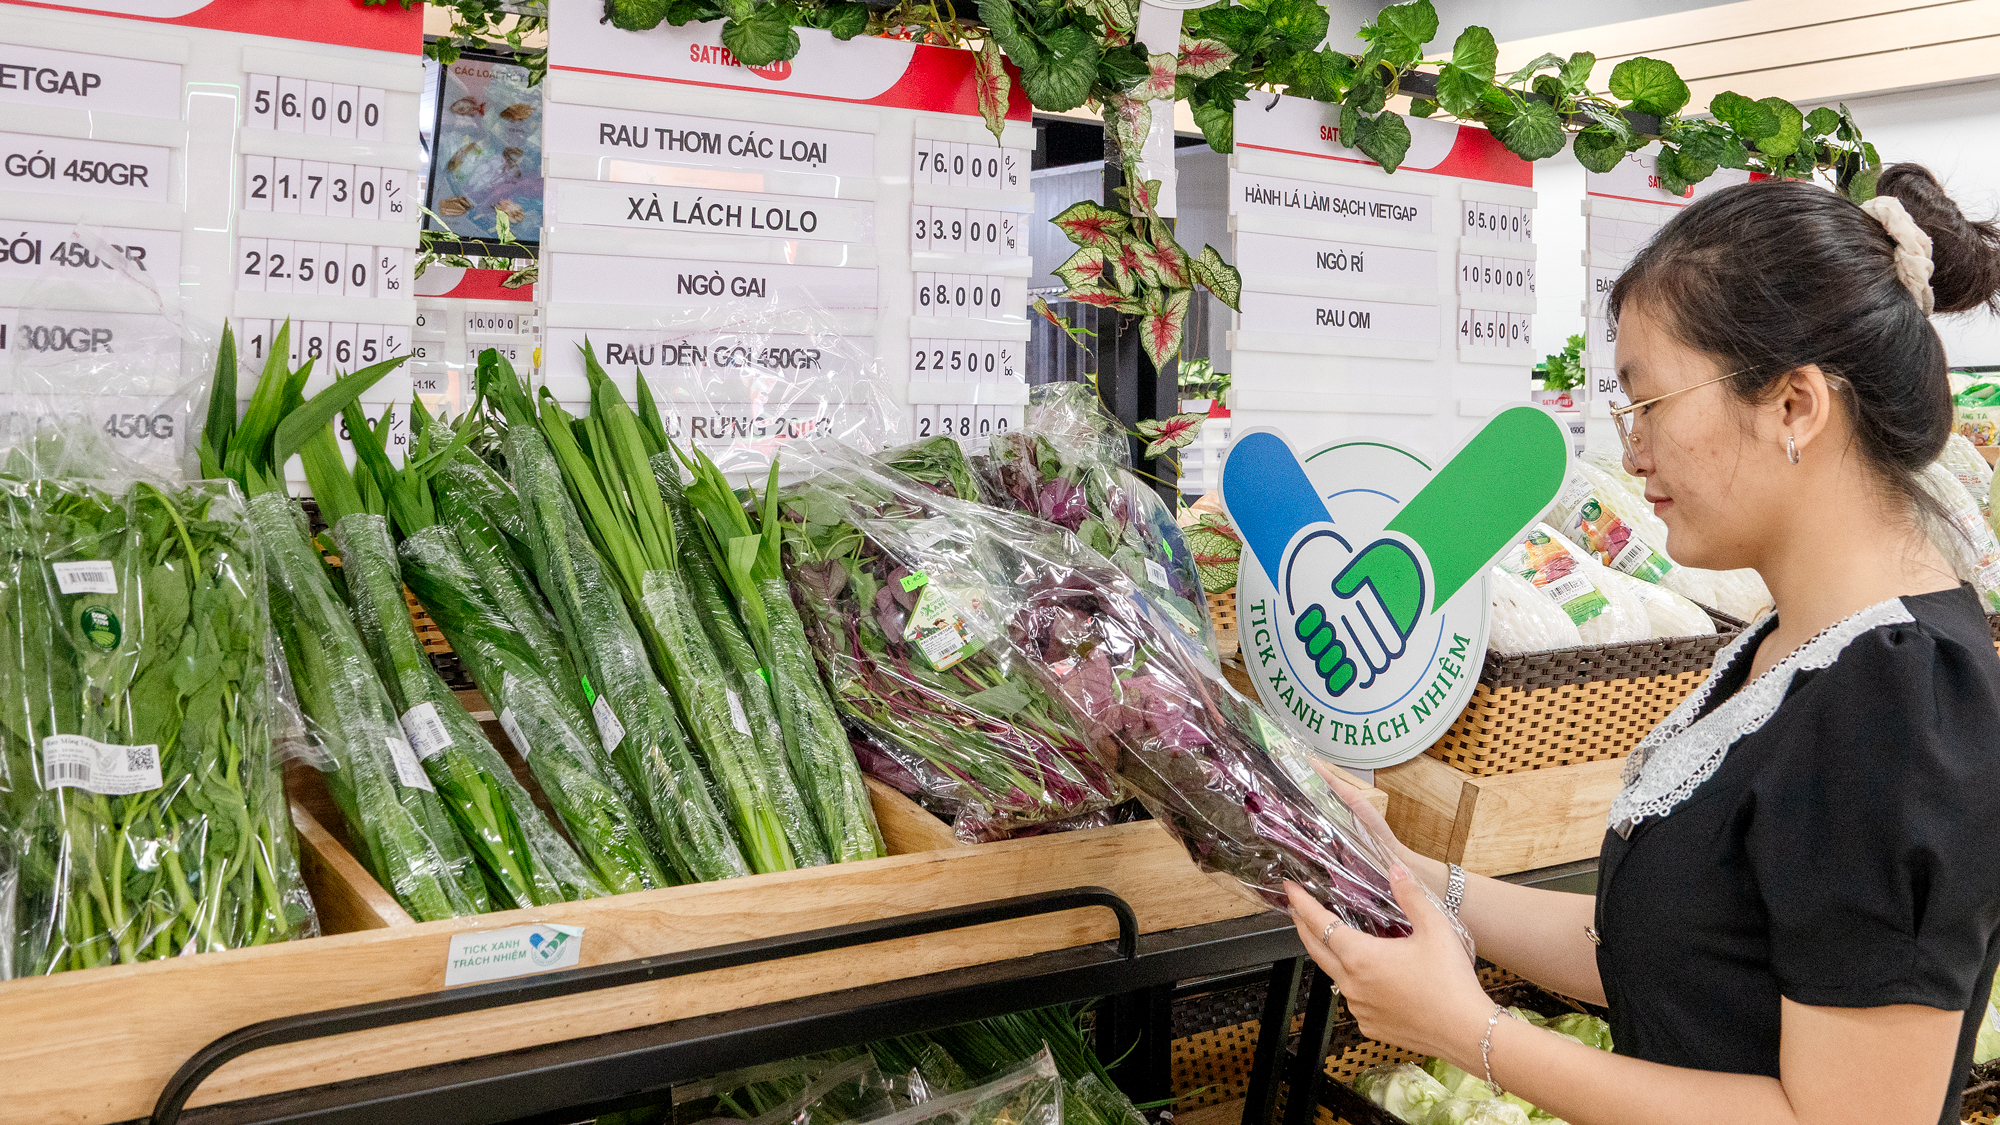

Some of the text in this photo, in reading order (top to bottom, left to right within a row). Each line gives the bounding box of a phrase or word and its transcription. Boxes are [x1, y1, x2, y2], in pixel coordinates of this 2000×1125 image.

[454, 66, 475, 76] CÁC
[254, 90, 379, 127] 56.000
[599, 123, 827, 168] RAU THƠM CÁC LOẠI
[4, 150, 149, 188] GÓI 450GR
[918, 152, 998, 178] 76.000
[251, 175, 375, 205] 21.730
[1008, 173, 1017, 185] kg
[390, 201, 403, 213] bó
[627, 193, 818, 233] XÀ LÁCH LOLO
[1245, 184, 1418, 222] HÀNH LÁ LÀM SẠCH VIETGAP
[915, 219, 997, 243] 33.900
[1468, 210, 1519, 233] 85.000
[1006, 237, 1015, 249] kg
[50, 242, 147, 272] 450R
[244, 251, 366, 287] 22.500
[1316, 249, 1364, 273] NGÒ RÍ
[387, 277, 400, 290] bó
[677, 271, 766, 299] NGÒ GAI
[1462, 265, 1523, 287] 105000
[920, 284, 1001, 308] 68.000
[468, 318, 513, 330] 10.000
[1316, 308, 1370, 329] RAU OM
[1461, 320, 1519, 340] 46.500
[18, 324, 114, 353] 300GR
[251, 334, 377, 363] 1.865
[470, 349, 516, 360] 175
[606, 343, 655, 366] RAU
[756, 347, 822, 370] 450GR
[915, 350, 995, 373] 22500
[103, 413, 174, 440] 450G
[919, 416, 1008, 438] 23800
[394, 433, 406, 445] bó
[1250, 599, 1471, 746] TICK XANH TRÁCH NHIỆM
[453, 954, 490, 969] TRÁCH
[493, 949, 527, 964] NHIỆM
[463, 939, 520, 956] TICK XANH
